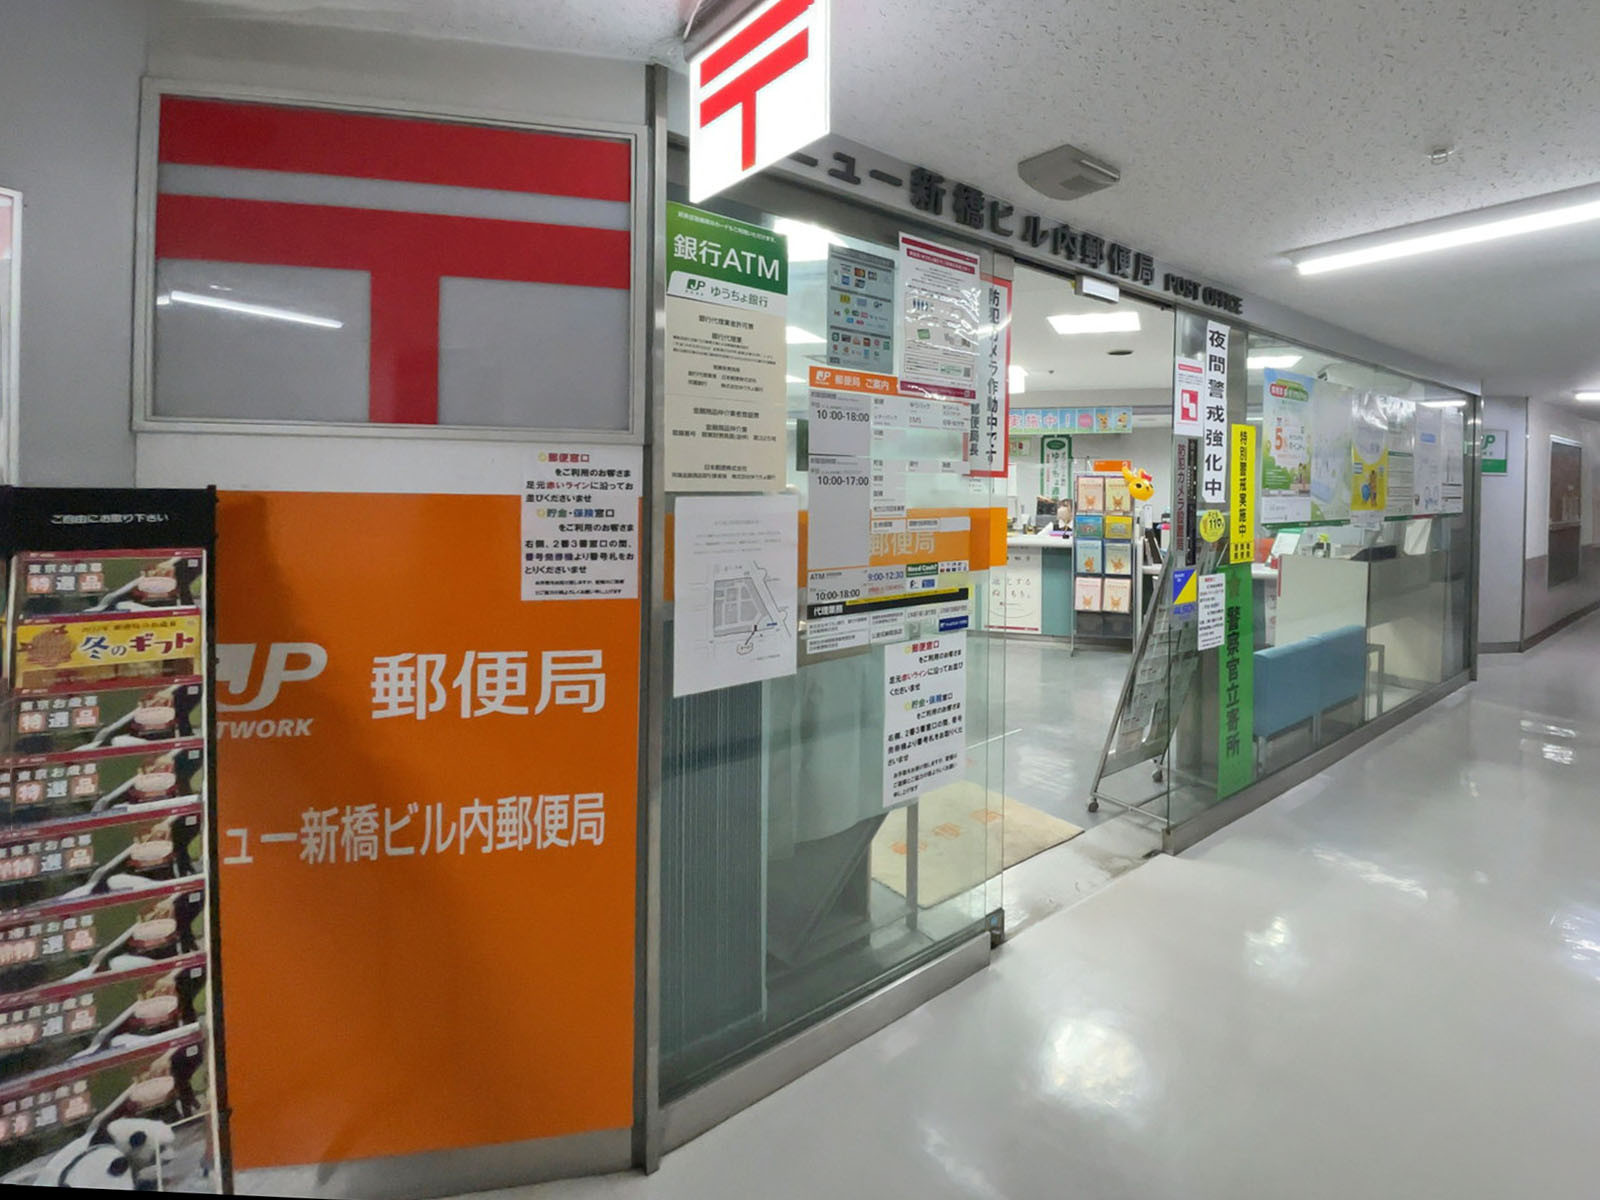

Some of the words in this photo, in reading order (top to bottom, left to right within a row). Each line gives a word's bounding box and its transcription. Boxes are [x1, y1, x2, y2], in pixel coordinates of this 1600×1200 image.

[674, 233, 780, 281] 銀行ATM
[711, 286, 768, 308] ゆうちょ銀行
[1164, 273, 1201, 300] POST
[1202, 286, 1243, 315] OFFICE
[1204, 330, 1226, 497] 夜間警戒強化中
[547, 452, 590, 463] 郵便窓口
[555, 468, 632, 478] をご利用のお客さま
[526, 480, 634, 491] 足元赤いラインに沿ってお
[818, 476, 870, 486] 10:00-17:00
[525, 494, 592, 503] 並びくださいませ
[51, 512, 170, 525] ご自由にお取り下さい
[546, 508, 615, 518] 貯金・保険窓口
[558, 523, 635, 533] をご利用のお客さま
[524, 565, 587, 575] とりくださいませ
[815, 589, 861, 601] 10:00-18:00
[80, 631, 195, 661] 冬のギフト
[918, 649, 962, 664] をご利用のお客さま
[216, 641, 328, 713] JP
[1226, 605, 1241, 758] 警察官立寄所
[369, 648, 607, 721] 郵便局
[889, 683, 921, 697] くださいませ
[916, 702, 961, 720] をご利用のお客さま
